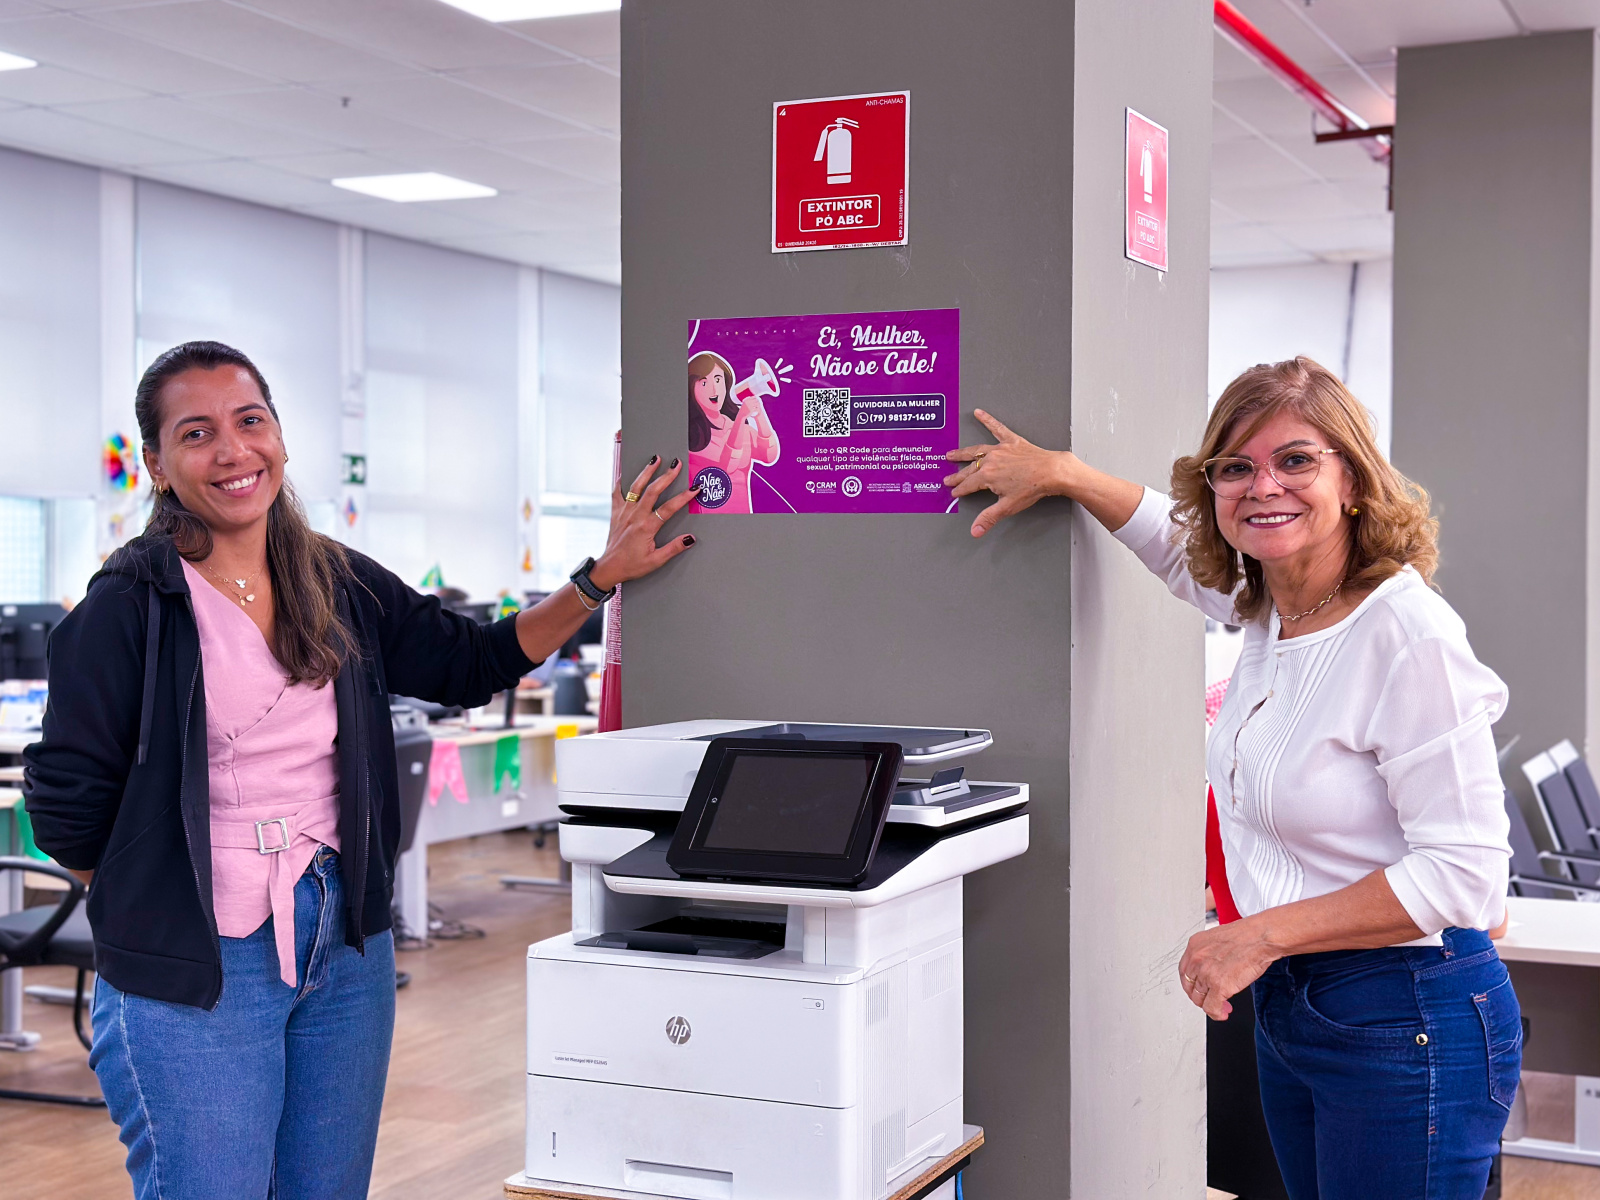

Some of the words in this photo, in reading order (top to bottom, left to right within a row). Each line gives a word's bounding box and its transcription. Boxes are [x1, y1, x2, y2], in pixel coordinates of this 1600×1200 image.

[866, 97, 904, 106] ANTI-CHAMAS
[808, 199, 872, 213] EXTINTOR
[816, 214, 833, 227] PÓ
[837, 214, 864, 226] ABC
[1137, 216, 1158, 232] EXTINTOR
[1146, 233, 1155, 245] ABC
[818, 326, 842, 350] Ei,
[850, 324, 926, 347] Mulher,
[810, 354, 852, 378] Não
[854, 360, 878, 374] se
[884, 351, 938, 374] Cale!
[853, 401, 894, 409] OUVIDORIA
[896, 400, 907, 408] DA
[908, 399, 940, 407] MULHER
[870, 413, 886, 423] (79)
[889, 412, 936, 422] 98137-1409
[872, 447, 890, 455] para
[892, 445, 932, 453] denunciar
[796, 455, 830, 463] qualquer
[832, 455, 847, 463] tipo
[861, 454, 898, 462] violência:
[900, 453, 924, 462] física,
[806, 463, 834, 471] sexual,
[835, 463, 880, 471] patrimonial
[892, 462, 940, 470] psicológica.
[699, 473, 721, 489] Não
[702, 486, 725, 502] Não!
[669, 1016, 689, 1045] hp
[814, 1123, 824, 1137] 2
